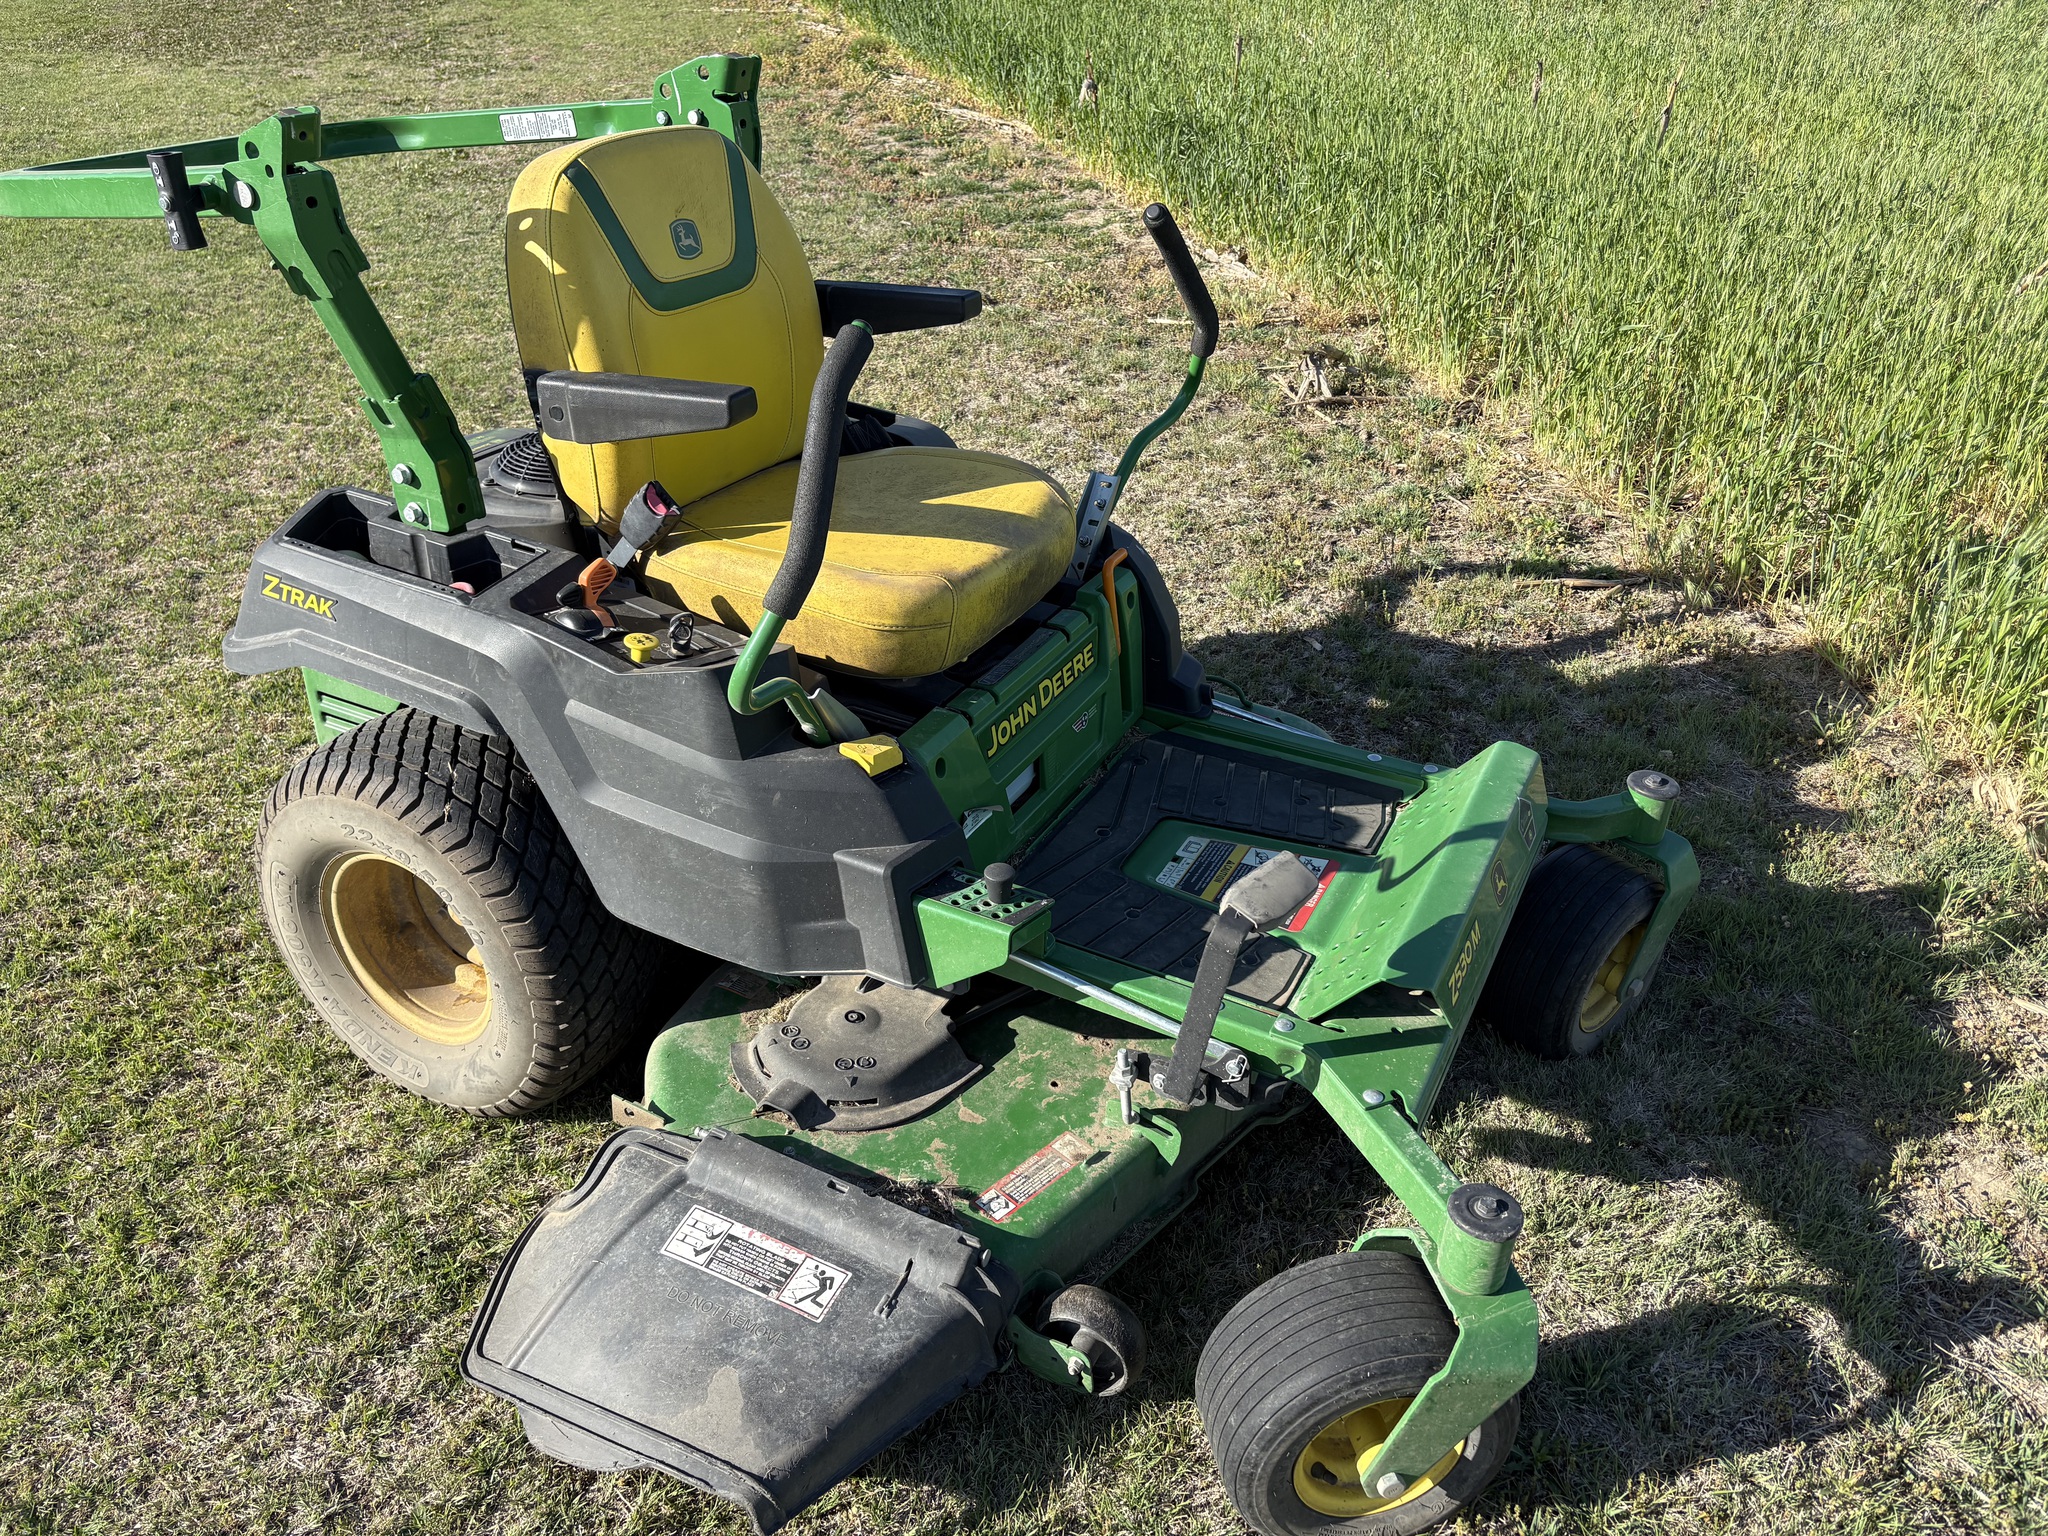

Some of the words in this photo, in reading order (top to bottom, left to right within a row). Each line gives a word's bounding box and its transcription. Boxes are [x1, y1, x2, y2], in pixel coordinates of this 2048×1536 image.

[261, 573, 334, 619] ZTRAK
[987, 694, 1037, 757] JOHN
[1038, 642, 1095, 710] DEERE
[326, 997, 419, 1080] KENDA
[1015, 1155, 1041, 1176] DANGER
[728, 1249, 753, 1262] THROWN
[752, 1260, 779, 1274] OBJECTS
[737, 1239, 766, 1254] ROTATING
[765, 1251, 785, 1263] BLADE
[667, 1286, 690, 1303] DO
[690, 1295, 723, 1317] NOT
[722, 1309, 787, 1347] REMOVE
